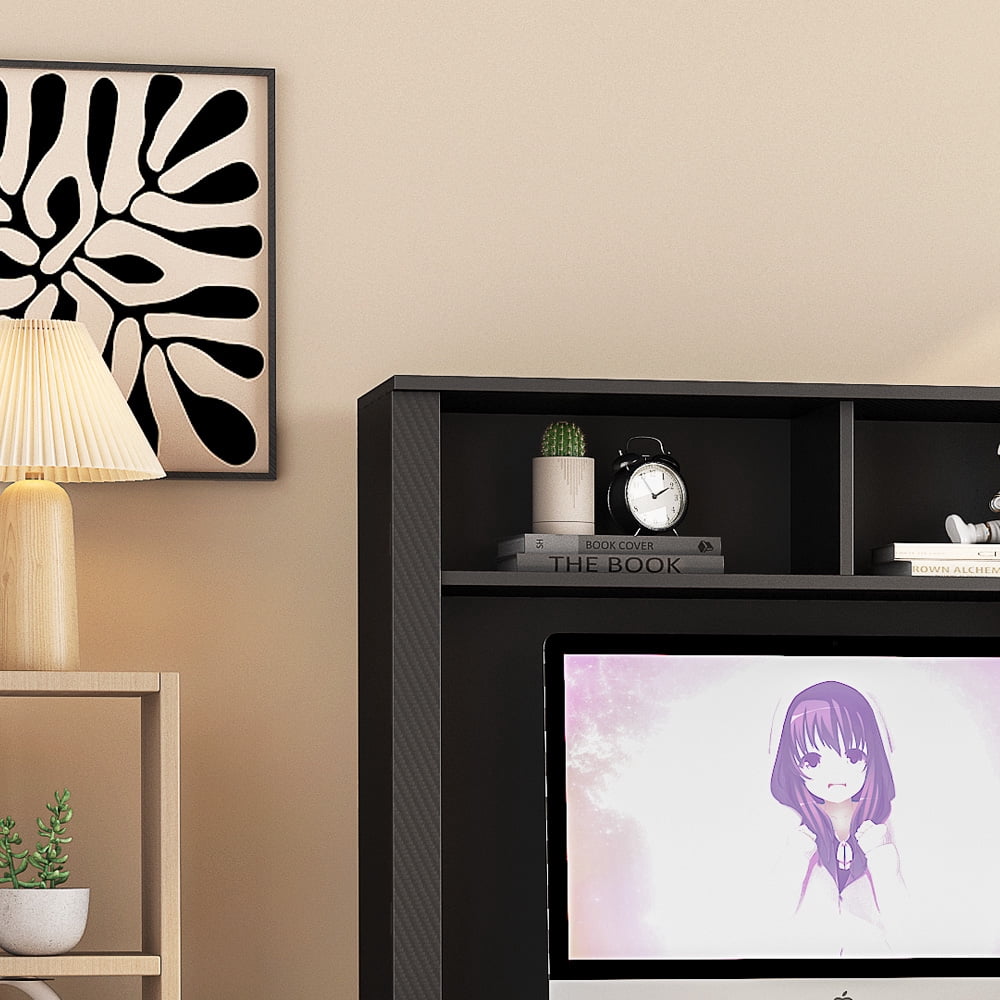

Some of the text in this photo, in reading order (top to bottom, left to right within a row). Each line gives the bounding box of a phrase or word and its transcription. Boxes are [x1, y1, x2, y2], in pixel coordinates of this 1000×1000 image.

[585, 540, 654, 551] BOOK COVER
[549, 556, 681, 574] THE BOOK
